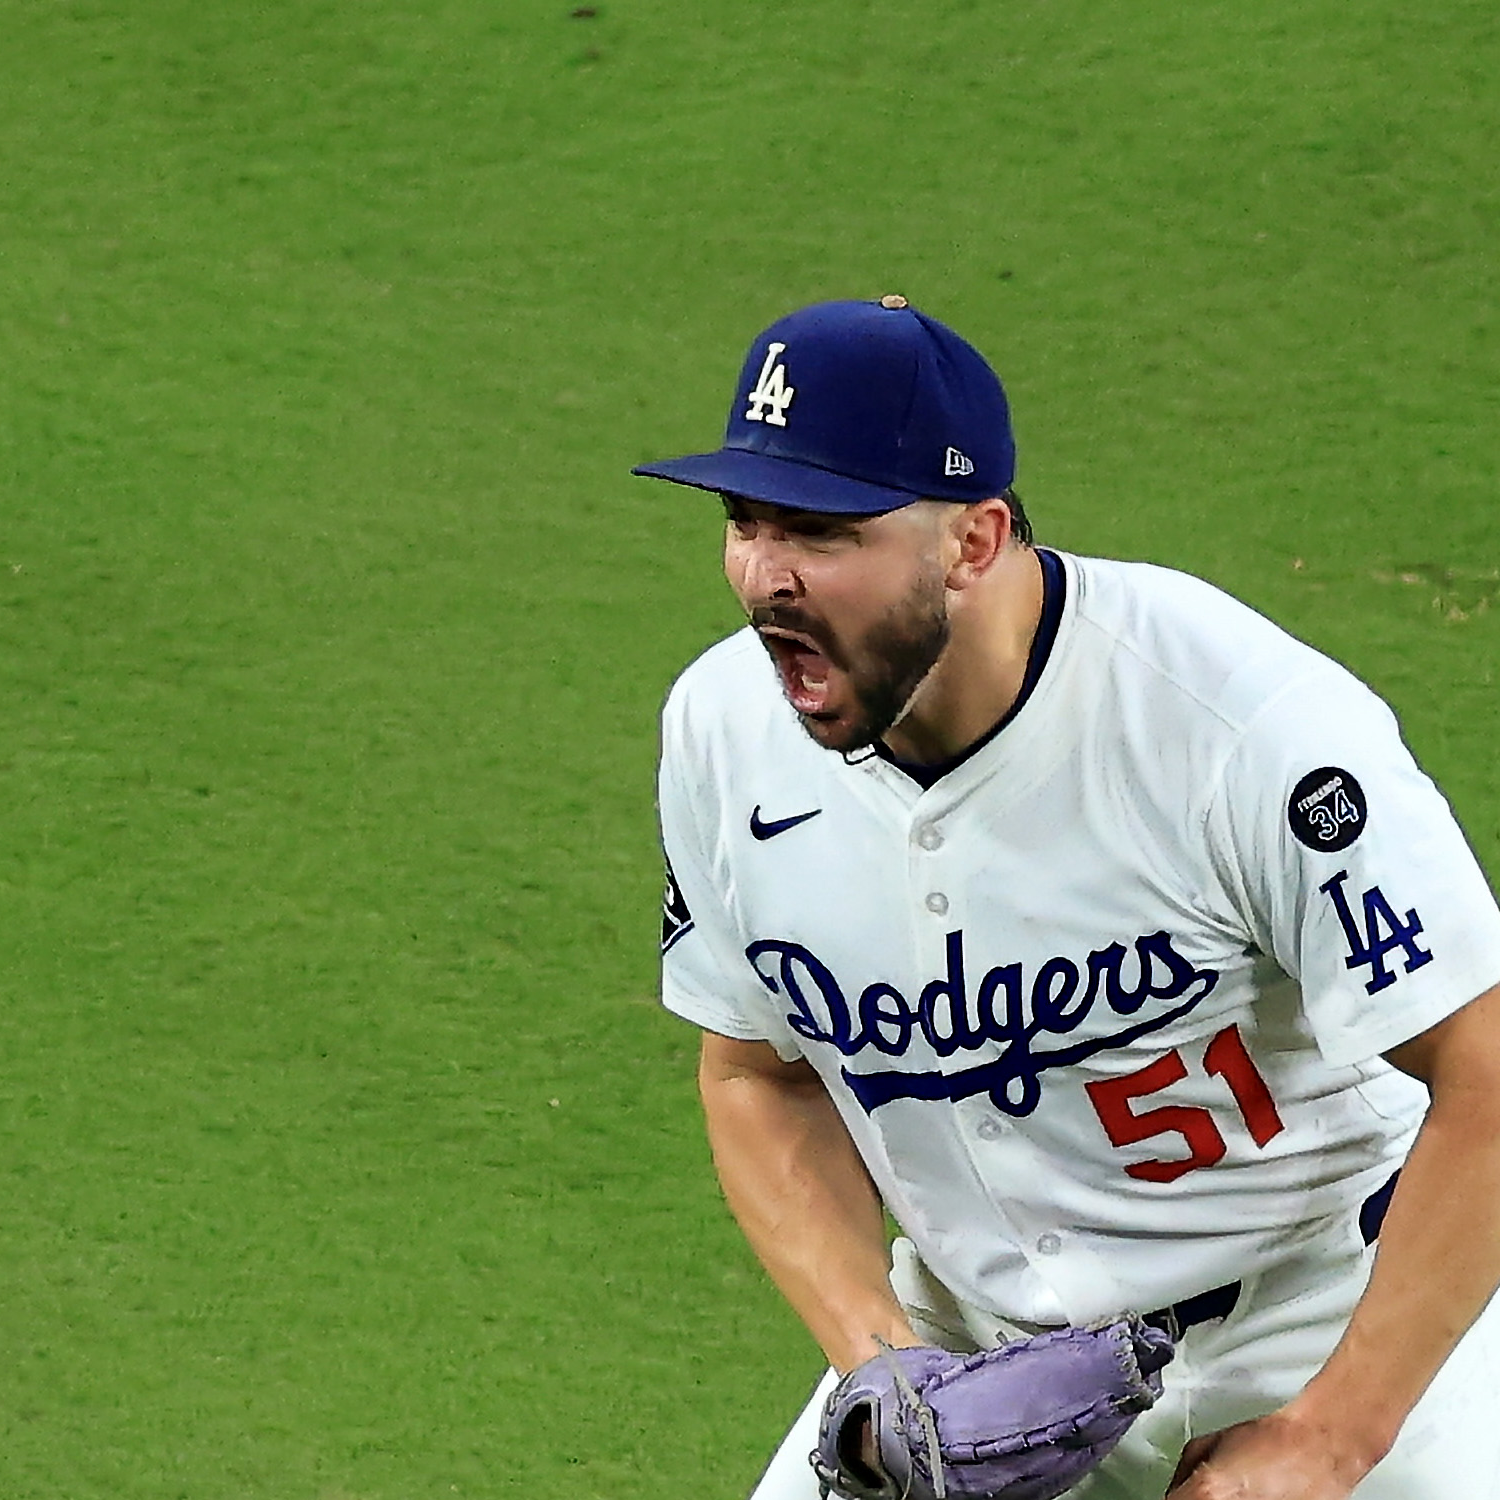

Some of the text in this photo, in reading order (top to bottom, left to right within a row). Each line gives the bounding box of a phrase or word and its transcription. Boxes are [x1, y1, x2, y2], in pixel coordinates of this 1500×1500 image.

[745, 342, 794, 427] LA
[1308, 788, 1360, 841] 34
[1318, 869, 1434, 996] LA
[745, 929, 1219, 1118] Dodgers
[1084, 1022, 1284, 1184] 51
